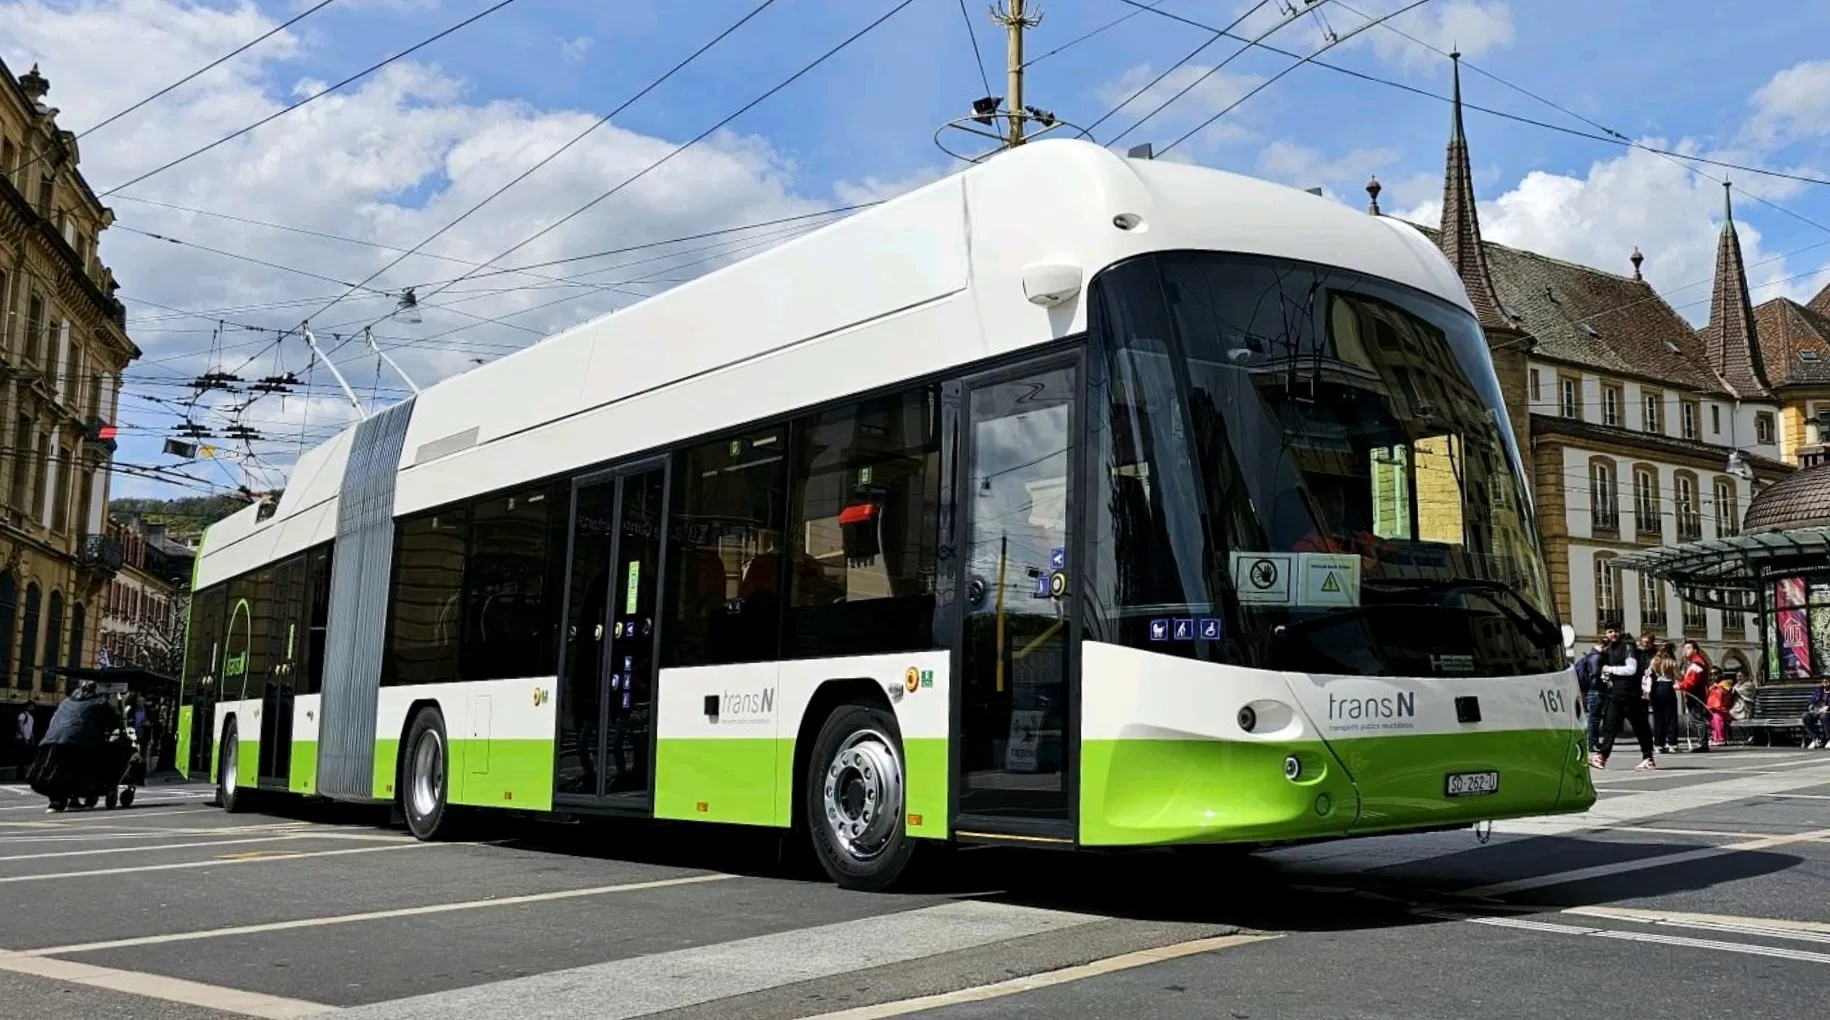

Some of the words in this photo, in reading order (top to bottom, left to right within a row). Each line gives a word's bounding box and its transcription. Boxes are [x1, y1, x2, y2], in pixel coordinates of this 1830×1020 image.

[722, 688, 775, 714] transN
[1328, 691, 1415, 720] transN
[1539, 689, 1566, 713] 161
